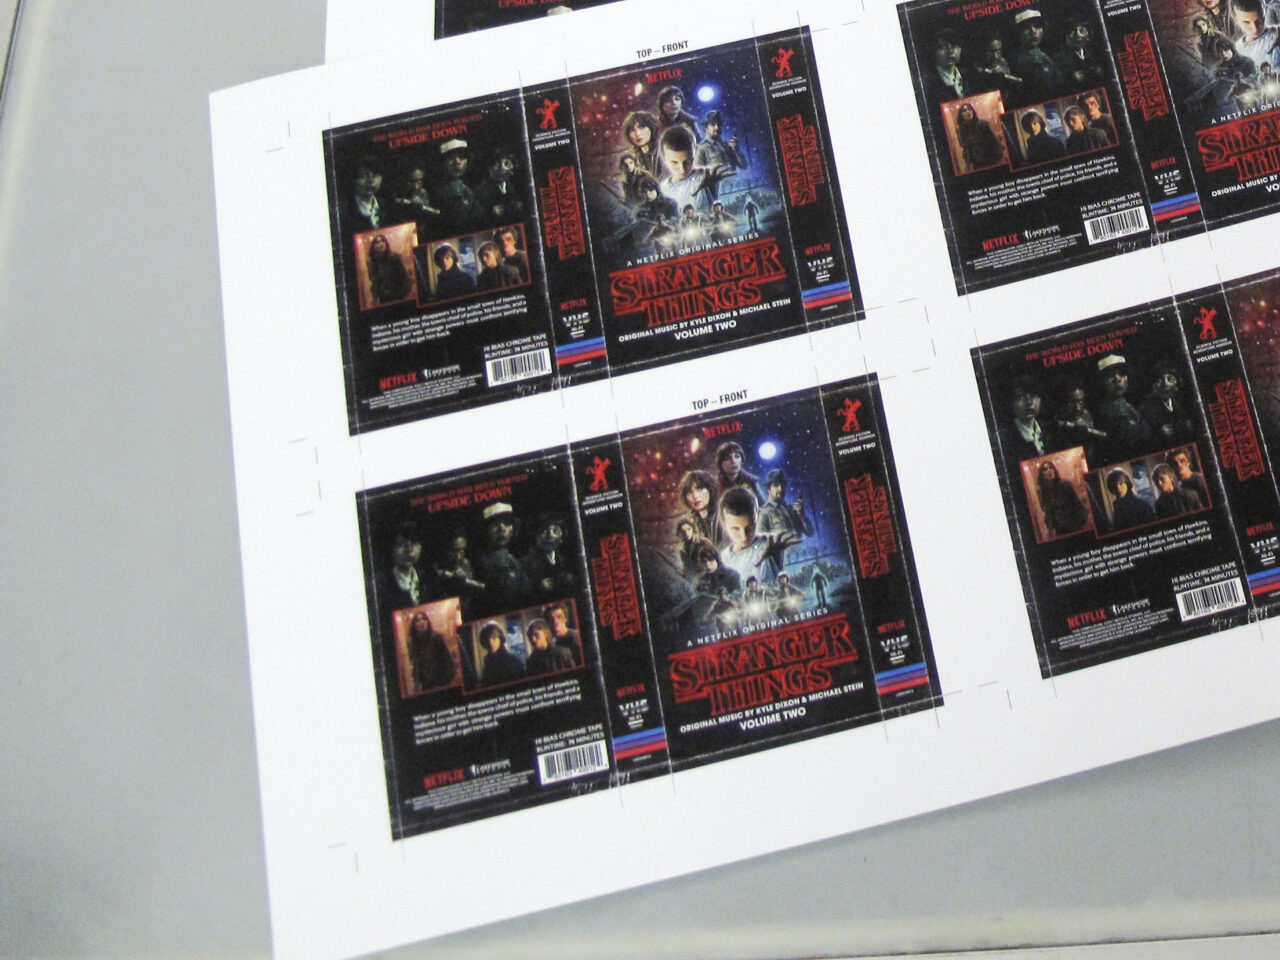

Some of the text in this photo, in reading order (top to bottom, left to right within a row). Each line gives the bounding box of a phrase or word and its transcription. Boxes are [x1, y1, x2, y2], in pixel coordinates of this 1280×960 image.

[962, 3, 1001, 21] UPSIDE
[635, 39, 690, 59] TOP FRONT
[646, 67, 682, 84] NETFLIX
[1219, 106, 1257, 121] NETFLIX
[1210, 182, 1245, 197] ORIGINAL
[1244, 176, 1269, 188] MUSIC
[1268, 173, 1278, 182] BY
[635, 250, 674, 264] NETFLIX
[677, 239, 723, 255] ORIGINAL
[726, 231, 759, 244] SERIES
[608, 235, 787, 315] STRANGER
[640, 275, 763, 328] THINGS
[617, 297, 792, 343] ORIGINAL MUSIC BY KYLE DIXON & MICHAEL STEIN
[673, 318, 737, 341] VOLUME TWO
[1041, 336, 1124, 368] UPSIDE DOWN
[690, 388, 749, 411] TOP FRONT
[703, 420, 742, 439] NETFLIX
[426, 484, 513, 514] UPSIDE DOWN
[685, 606, 828, 647] A NETFLIX ORIGINAL SERIES
[667, 611, 858, 702] STRANGER
[702, 656, 834, 716] THINGS
[678, 681, 864, 733] ORIGINAL MUSIC BY KYLE DIXON & MICHAEL STEIN
[738, 705, 807, 731] VOLUME TWO
